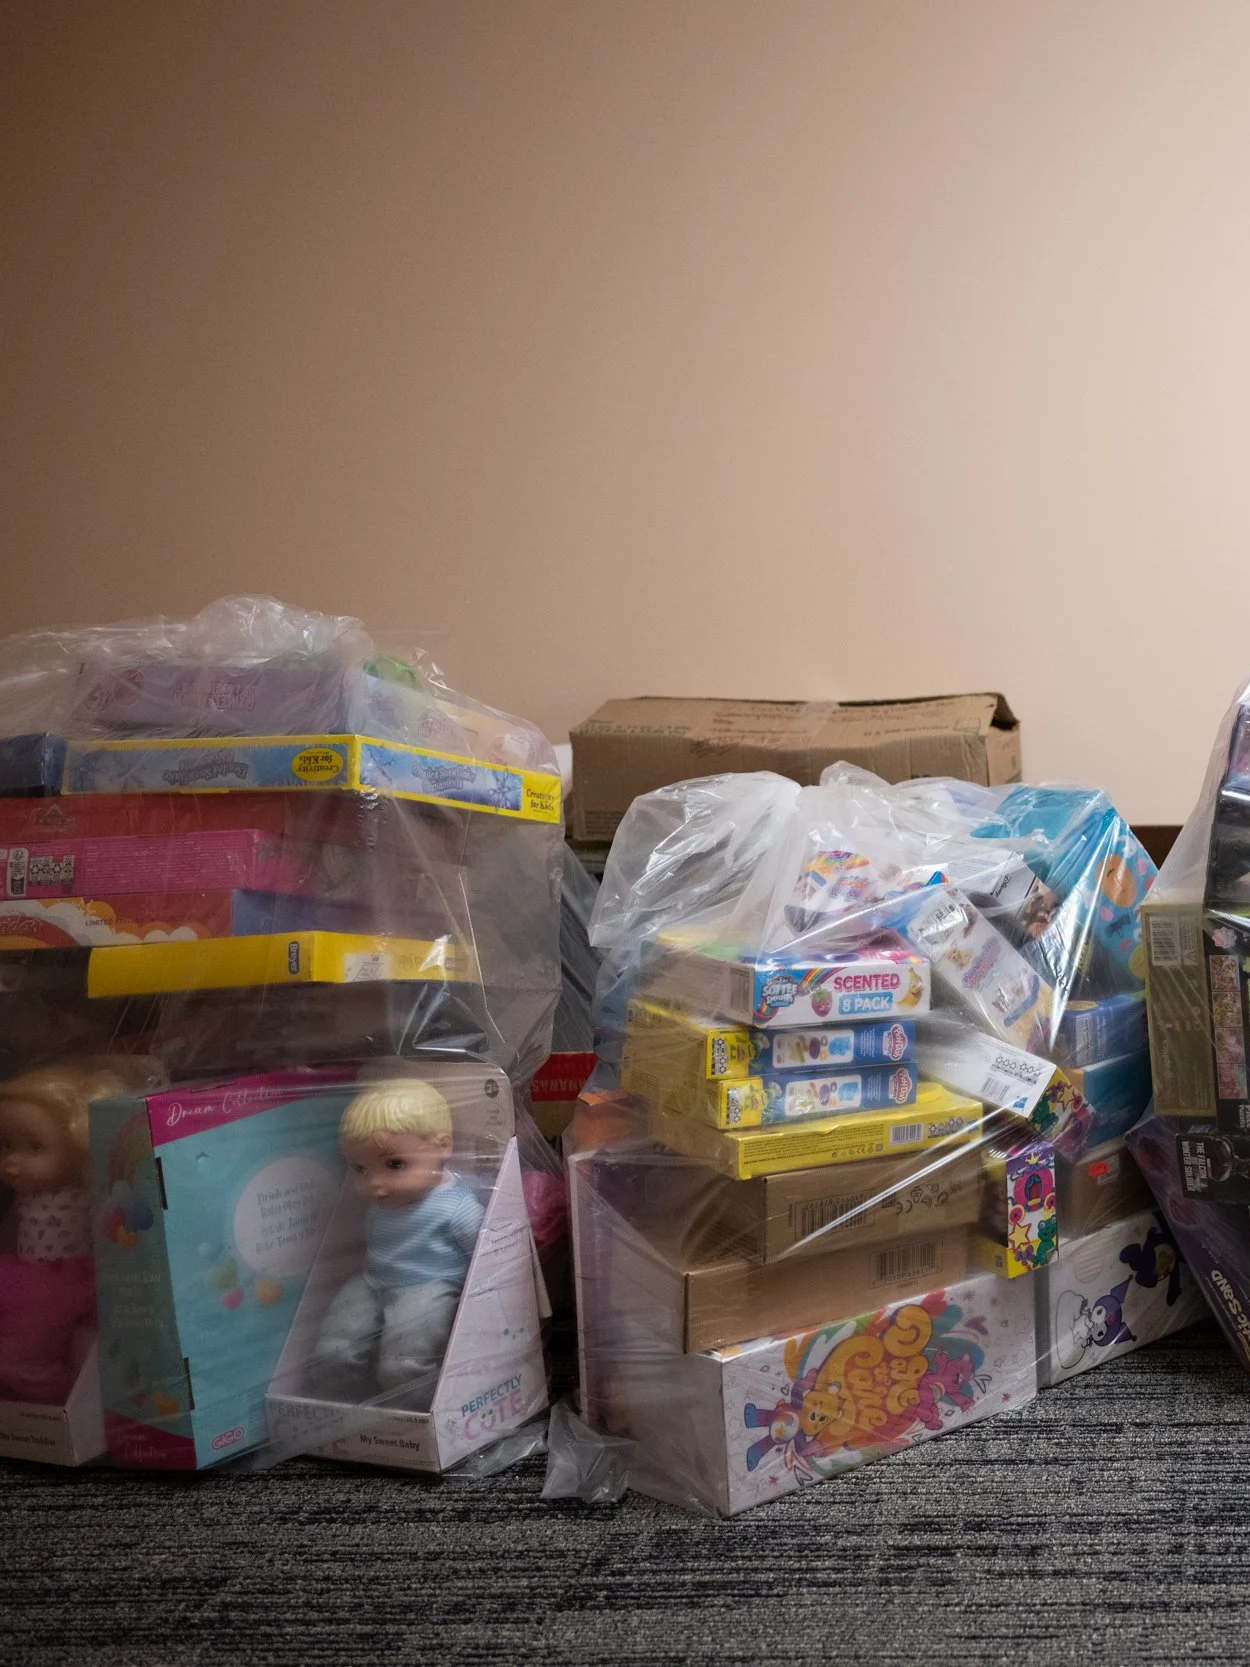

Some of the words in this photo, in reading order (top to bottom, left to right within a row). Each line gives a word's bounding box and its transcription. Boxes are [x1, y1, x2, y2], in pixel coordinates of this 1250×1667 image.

[300, 764, 341, 777] Creativity
[288, 941, 299, 974] Breyer
[833, 973, 901, 993] SCENTED
[841, 996, 851, 1012] 8
[855, 992, 894, 1011] PACK
[166, 1101, 216, 1128] Dream
[1181, 1140, 1190, 1165] WINTER
[1185, 1166, 1195, 1192] SOLDIER
[461, 1374, 523, 1416] PERFECTLY
[464, 1389, 526, 1442] CUTE
[211, 1428, 245, 1449] GIGO
[360, 1434, 372, 1446] My
[374, 1435, 397, 1447] Sweet
[399, 1438, 421, 1452] Baby
